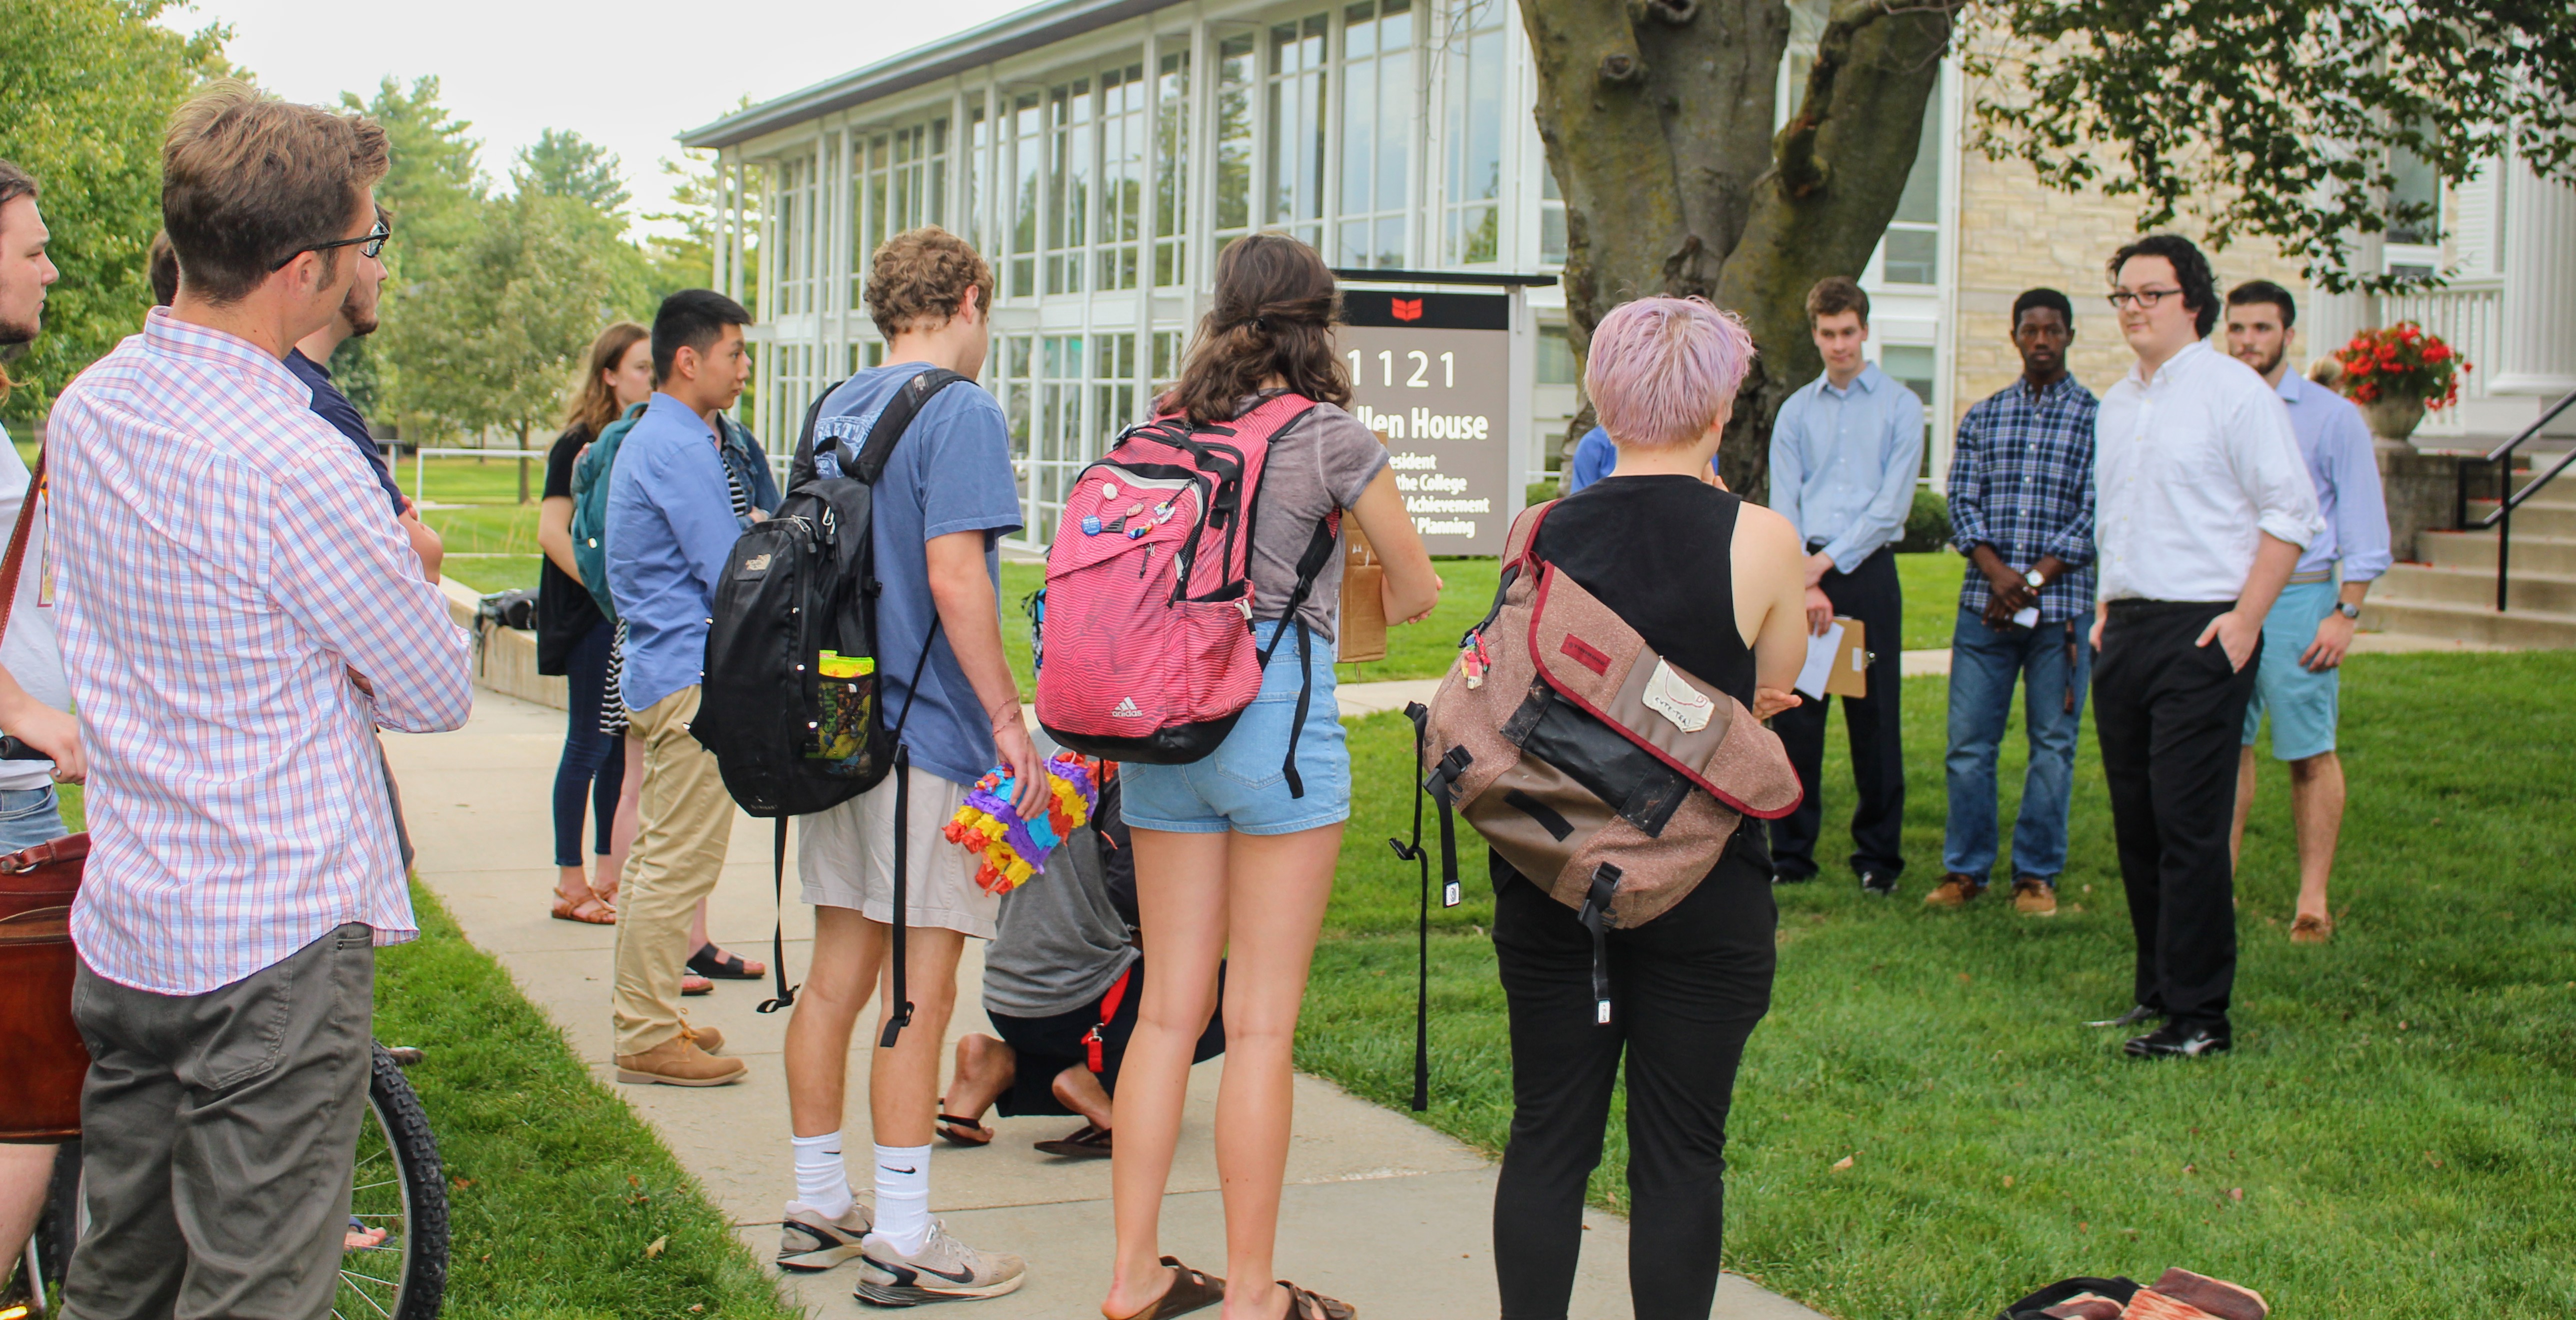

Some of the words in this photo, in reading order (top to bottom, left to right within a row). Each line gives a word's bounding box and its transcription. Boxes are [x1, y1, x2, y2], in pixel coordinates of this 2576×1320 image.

[1347, 350, 1454, 388] 1121
[1357, 405, 1405, 438] llen
[1411, 406, 1489, 440] House
[1388, 452, 1437, 470] esident
[1419, 473, 1467, 496] College
[1406, 495, 1490, 513] Achievement
[1417, 516, 1475, 538] Planning
[1111, 710, 1143, 718] adidas
